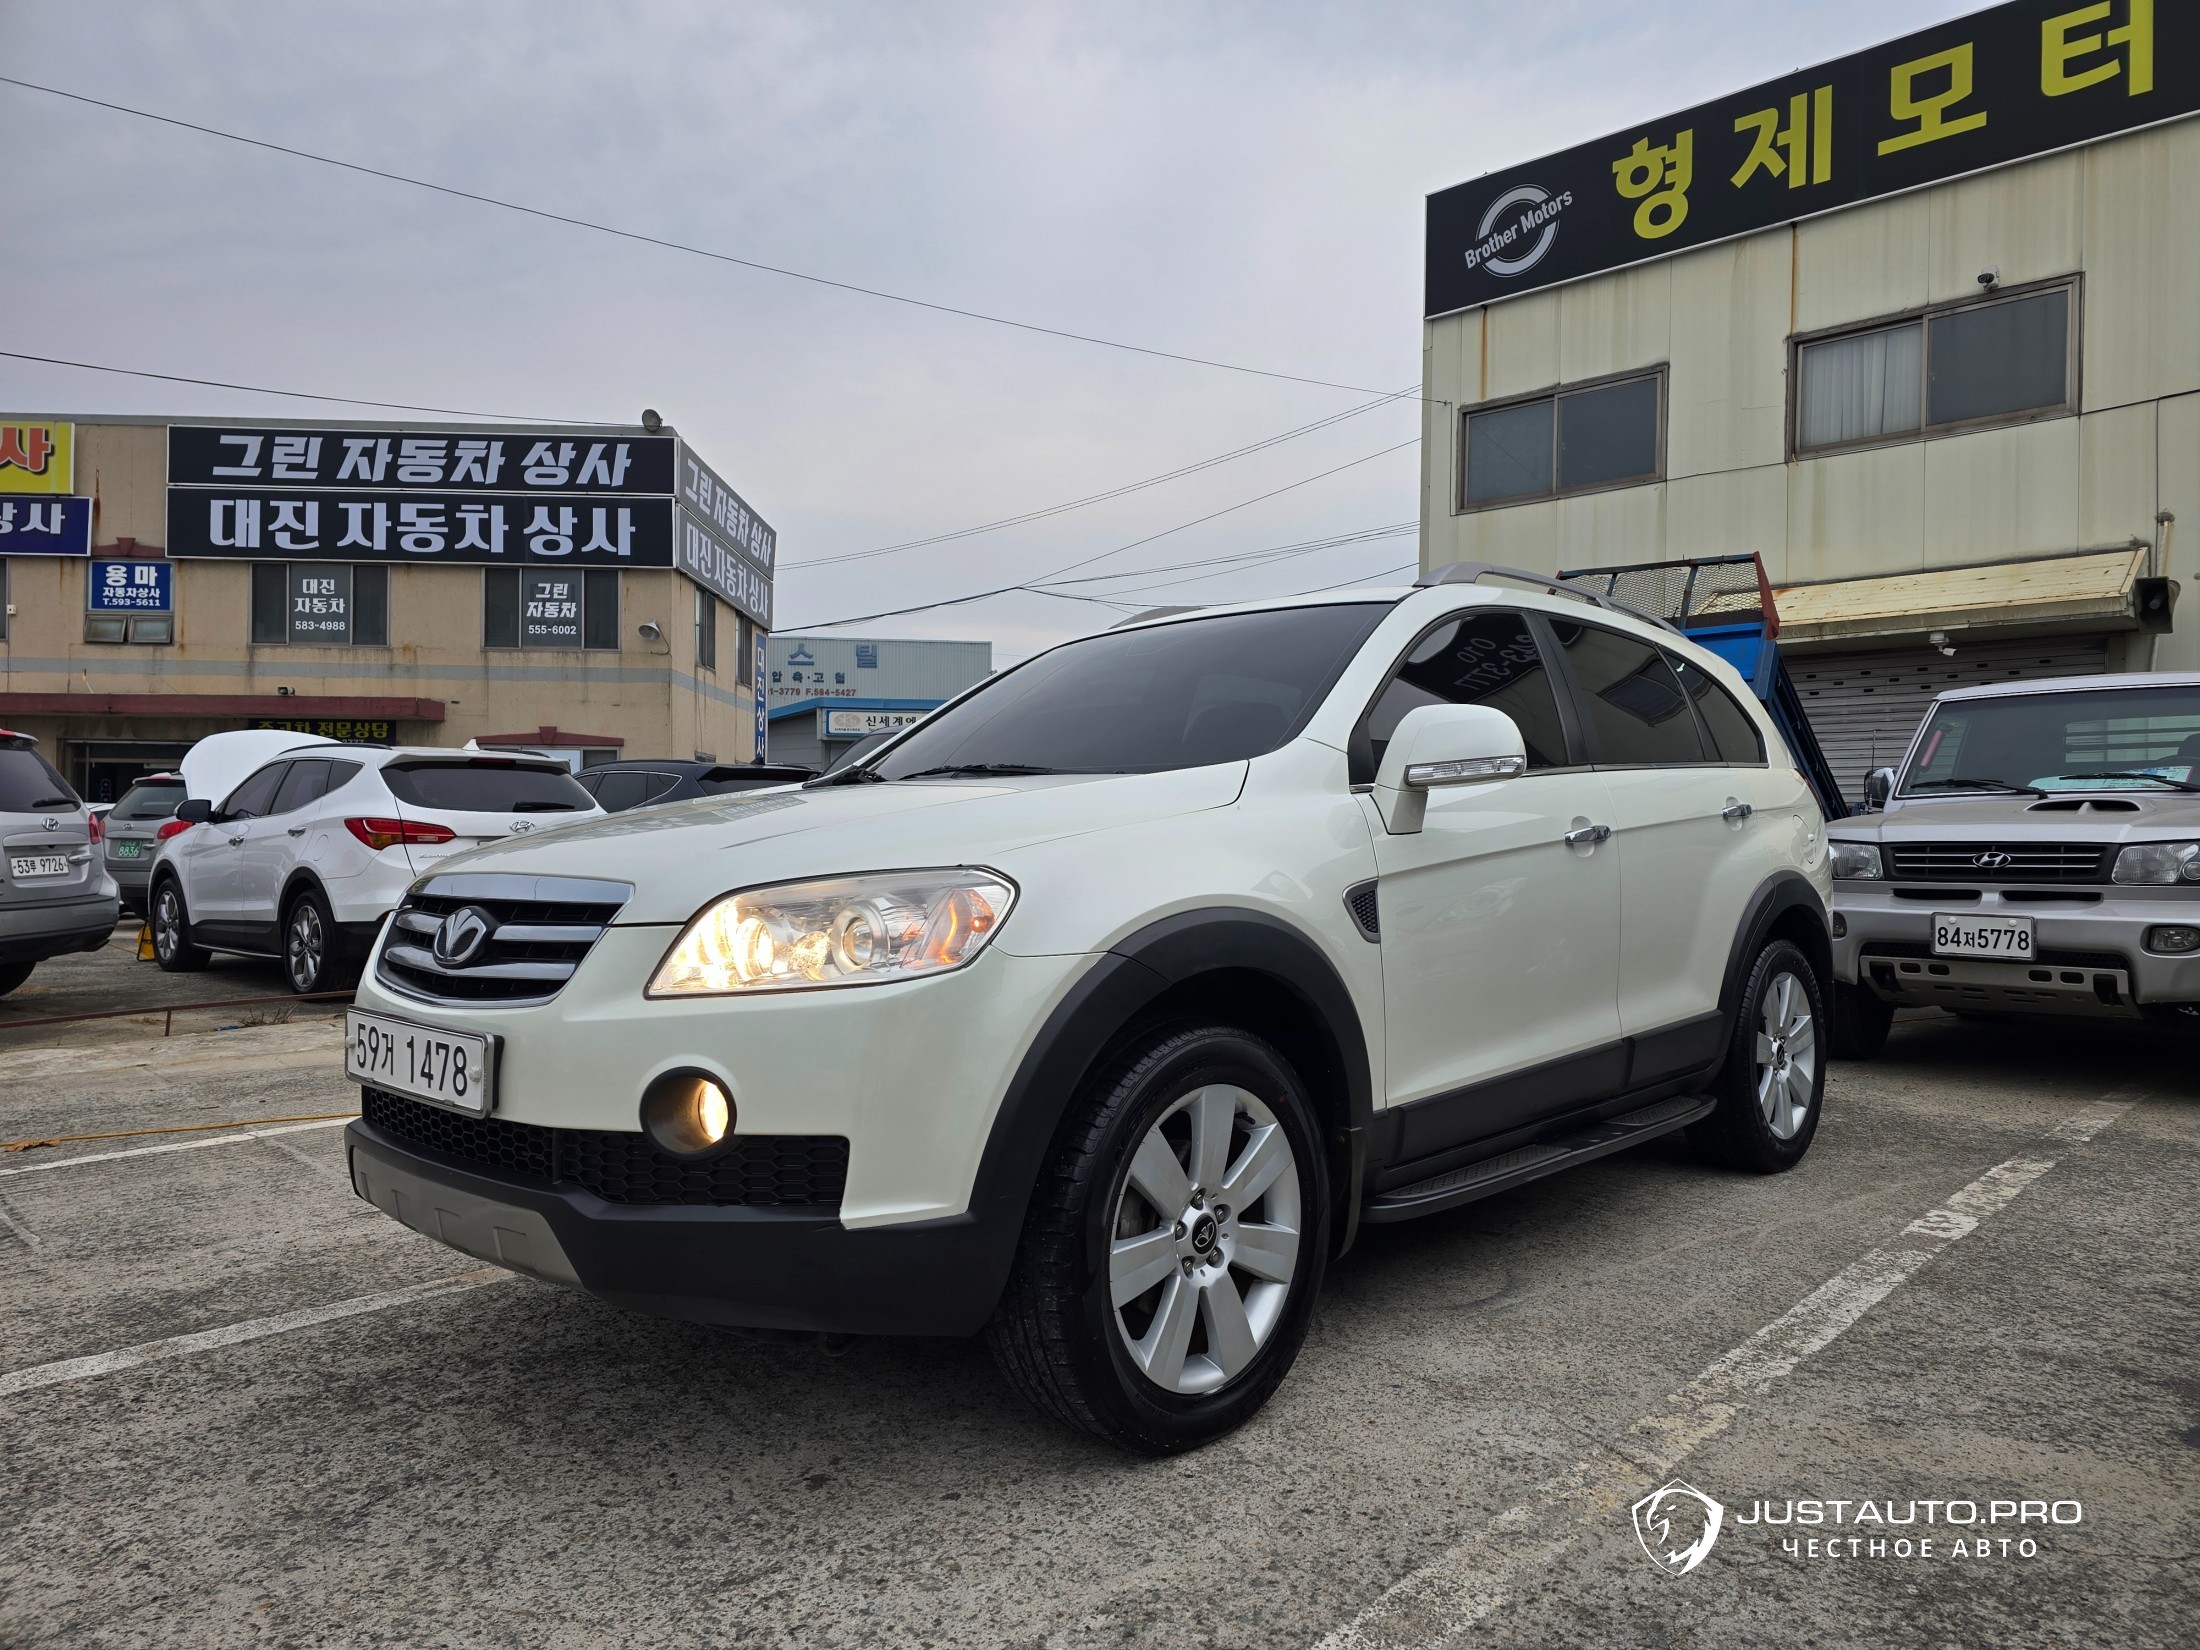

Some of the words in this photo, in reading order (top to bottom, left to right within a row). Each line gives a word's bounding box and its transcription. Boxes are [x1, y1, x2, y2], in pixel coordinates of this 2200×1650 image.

[1464, 225, 1517, 269] Brother
[1520, 190, 1573, 233] Motors
[212, 435, 324, 480] 그린
[336, 438, 505, 484] 자동차
[520, 442, 632, 487] 상사
[685, 458, 712, 516] 그린
[713, 485, 750, 548] 자동차
[751, 521, 772, 567] 상사
[209, 499, 320, 550] 대진
[336, 502, 509, 553] 자동차
[523, 506, 636, 556] 상사
[686, 521, 711, 579] 대진
[714, 544, 748, 605] 자동차
[749, 573, 769, 620] 상사
[102, 587, 160, 598] 자동차상사
[302, 578, 335, 595] 대진
[535, 583, 568, 600] 그린
[102, 598, 160, 607] T.593-5611
[294, 597, 345, 614] 자동차
[526, 601, 577, 618] 자동차
[295, 620, 346, 631] 583-4988
[528, 625, 577, 635] 555-6002
[767, 688, 800, 696] 1-3779
[756, 646, 765, 757] 대진상사
[118, 846, 139, 856] 8836
[40, 857, 64, 872] 9726
[1937, 926, 2030, 951] 84저5778
[357, 1022, 394, 1076] 59거
[406, 1035, 468, 1097] 1478
